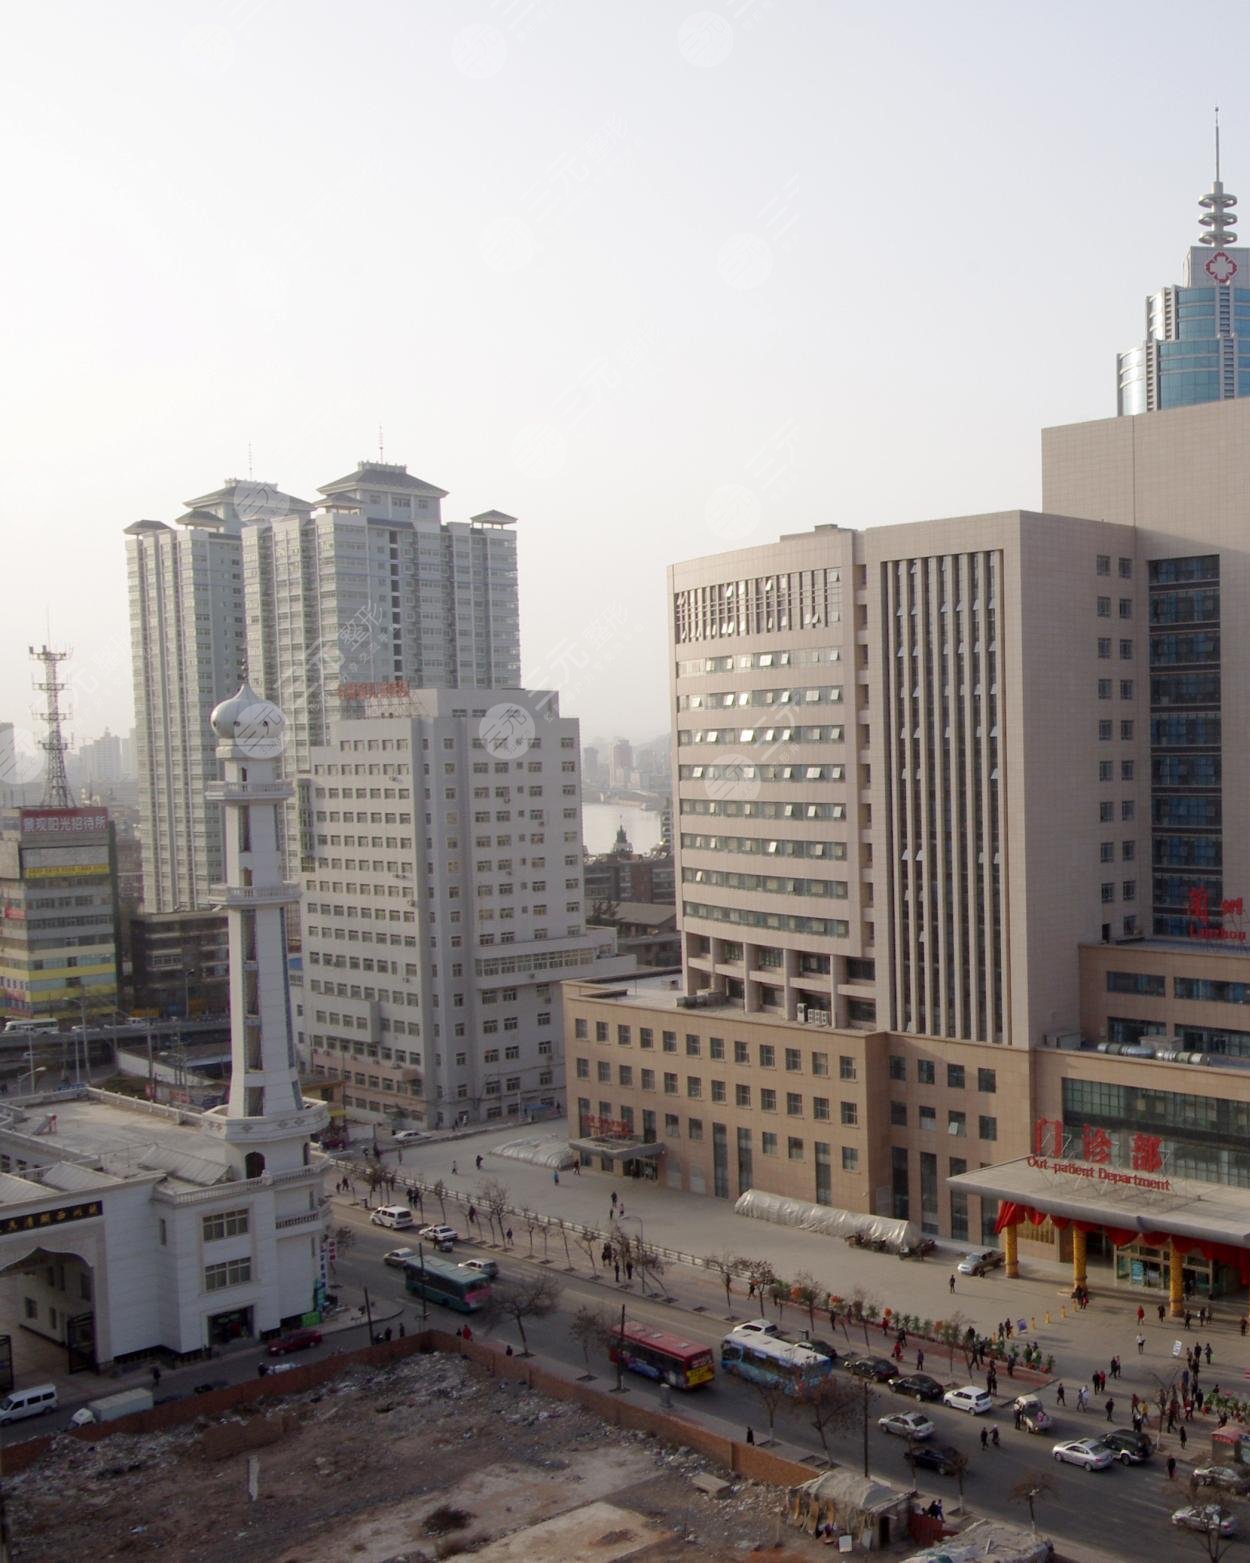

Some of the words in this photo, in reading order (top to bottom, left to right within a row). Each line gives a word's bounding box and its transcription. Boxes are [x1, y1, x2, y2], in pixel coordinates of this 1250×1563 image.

[1188, 921, 1247, 941] Lanzhou
[1034, 1118, 1163, 1173] 门诊部
[1098, 1167, 1170, 1192] Department
